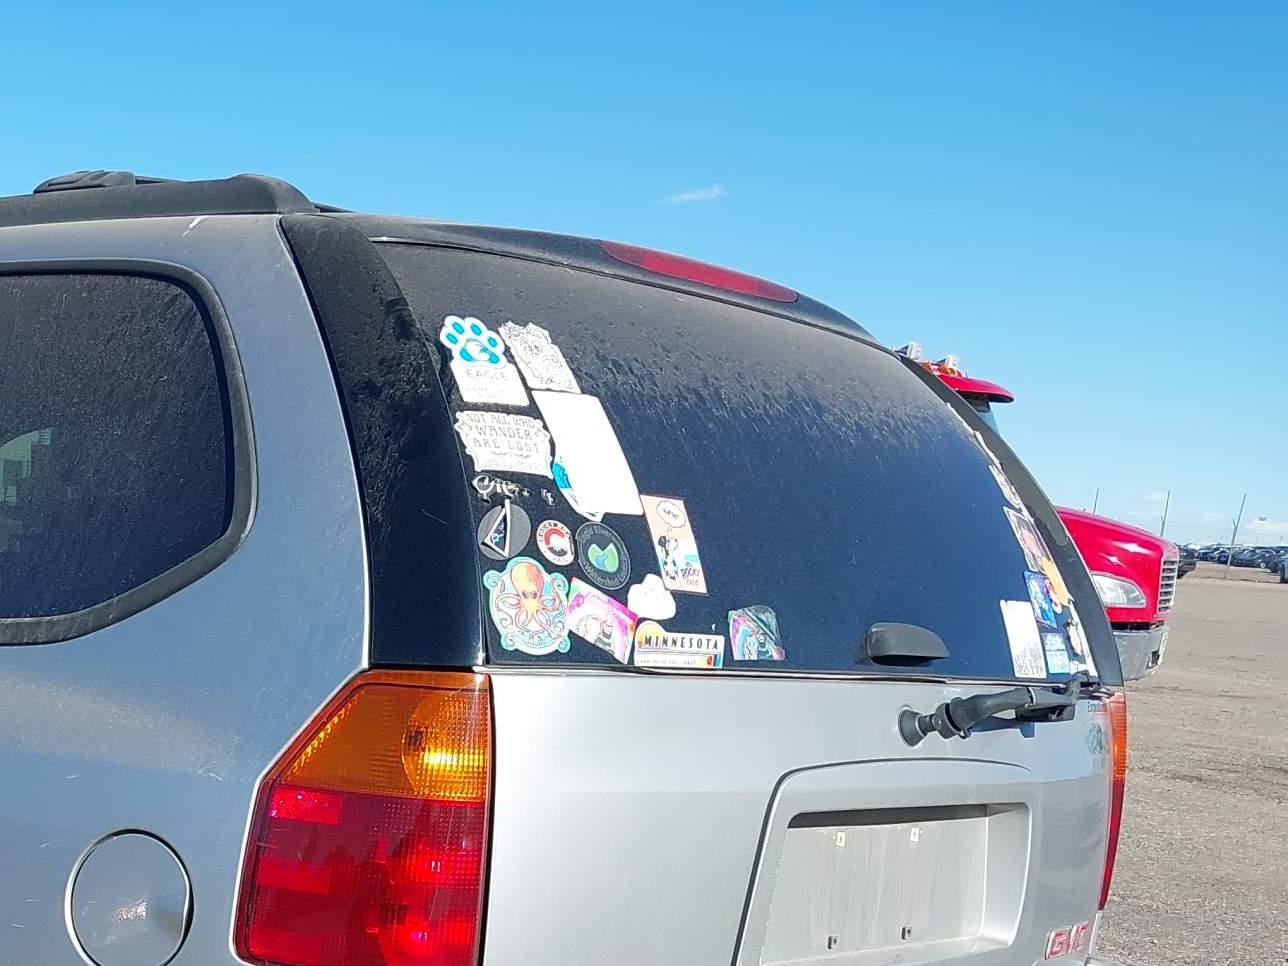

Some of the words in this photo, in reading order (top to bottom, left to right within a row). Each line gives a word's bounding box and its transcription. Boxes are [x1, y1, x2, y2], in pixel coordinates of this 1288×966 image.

[475, 425, 533, 440] WANDER
[474, 438, 500, 448] ARE
[644, 634, 719, 649] MINNESOTA
